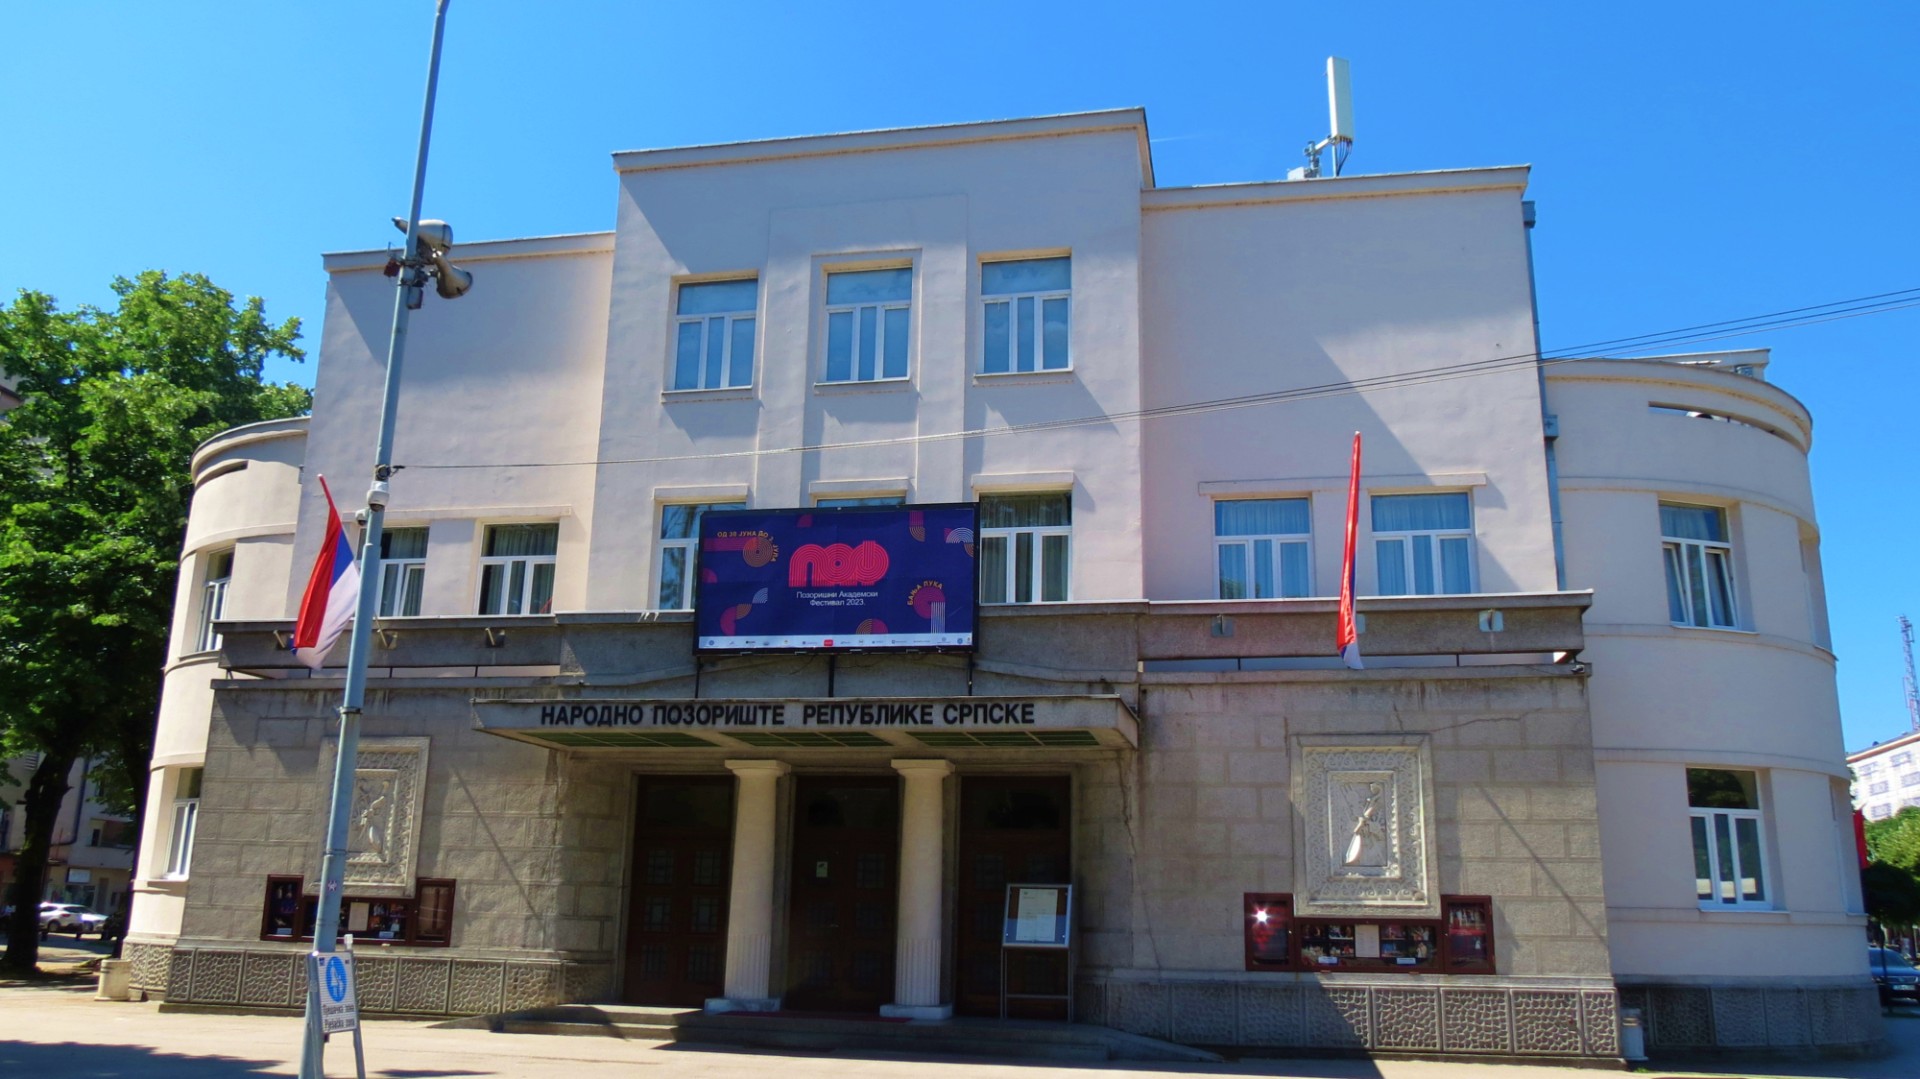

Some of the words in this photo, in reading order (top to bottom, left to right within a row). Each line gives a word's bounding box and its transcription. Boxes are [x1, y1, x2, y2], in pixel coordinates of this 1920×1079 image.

[796, 591, 837, 599] Позоришни
[838, 591, 879, 599] Академски
[809, 599, 845, 607] Фестивал
[541, 705, 643, 727] НАРОДНО
[653, 705, 785, 726] ПОЗОРИШТЕ
[802, 705, 933, 725] РЕПУБЛИКЕ
[943, 703, 1035, 724] СРПСКЕ
